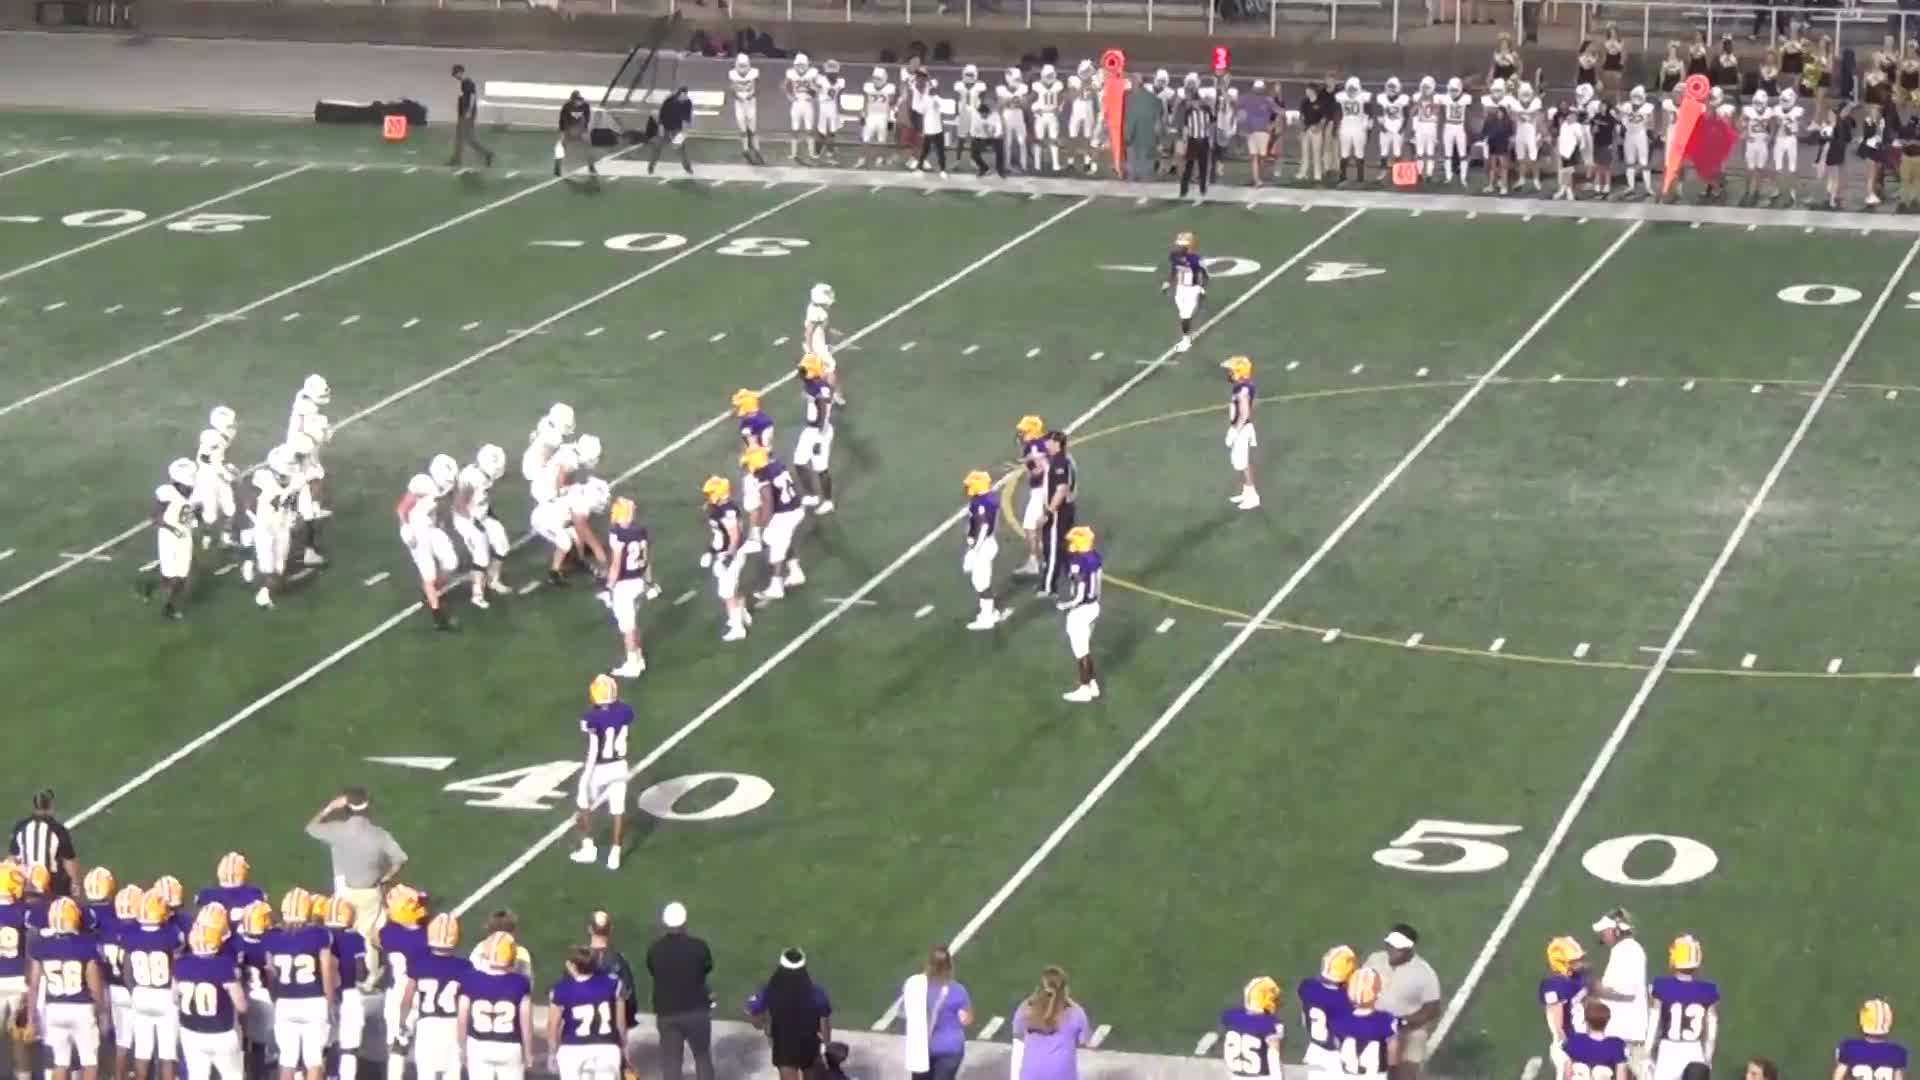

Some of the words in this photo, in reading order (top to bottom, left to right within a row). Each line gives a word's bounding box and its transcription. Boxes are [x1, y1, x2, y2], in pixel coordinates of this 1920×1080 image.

[442, 760, 776, 821] 40
[1372, 819, 1719, 887] 50
[130, 950, 170, 988] 88
[273, 953, 317, 985] 72
[176, 980, 218, 1016] 70
[417, 978, 462, 1013] 74
[470, 999, 517, 1034] 62
[570, 1003, 613, 1037] 71
[1668, 1001, 1705, 1042] 13
